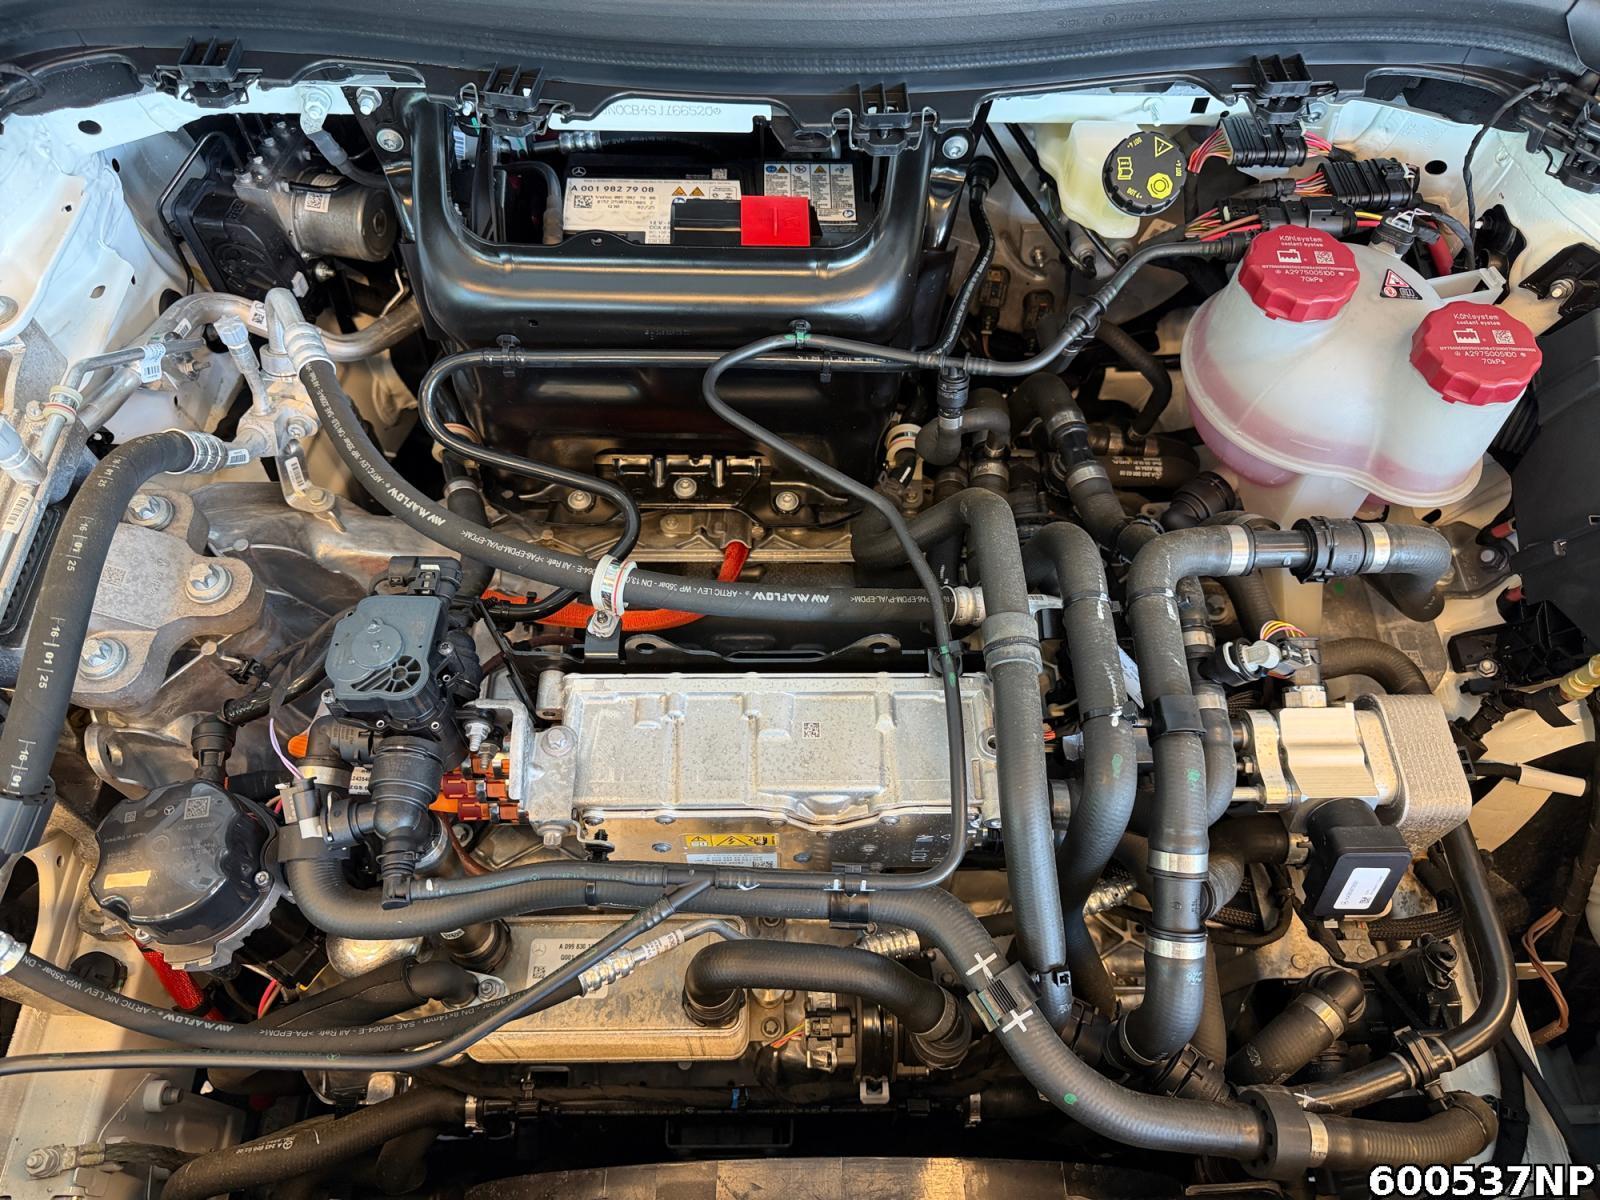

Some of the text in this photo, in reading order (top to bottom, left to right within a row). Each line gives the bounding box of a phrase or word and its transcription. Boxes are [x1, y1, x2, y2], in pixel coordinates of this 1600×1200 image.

[626, 185, 639, 193] 79
[66, 559, 77, 572] 25
[640, 579, 653, 588] DN
[679, 585, 692, 593] WP
[696, 587, 714, 596] LEV
[714, 588, 738, 598] ARTIC
[752, 591, 809, 603] MAFLOW
[44, 651, 55, 665] 01
[38, 675, 49, 689] 25
[11, 774, 22, 788] 01
[22, 955, 215, 1030] MAFLOW ARTIC NK LEV WP 35bar DN
